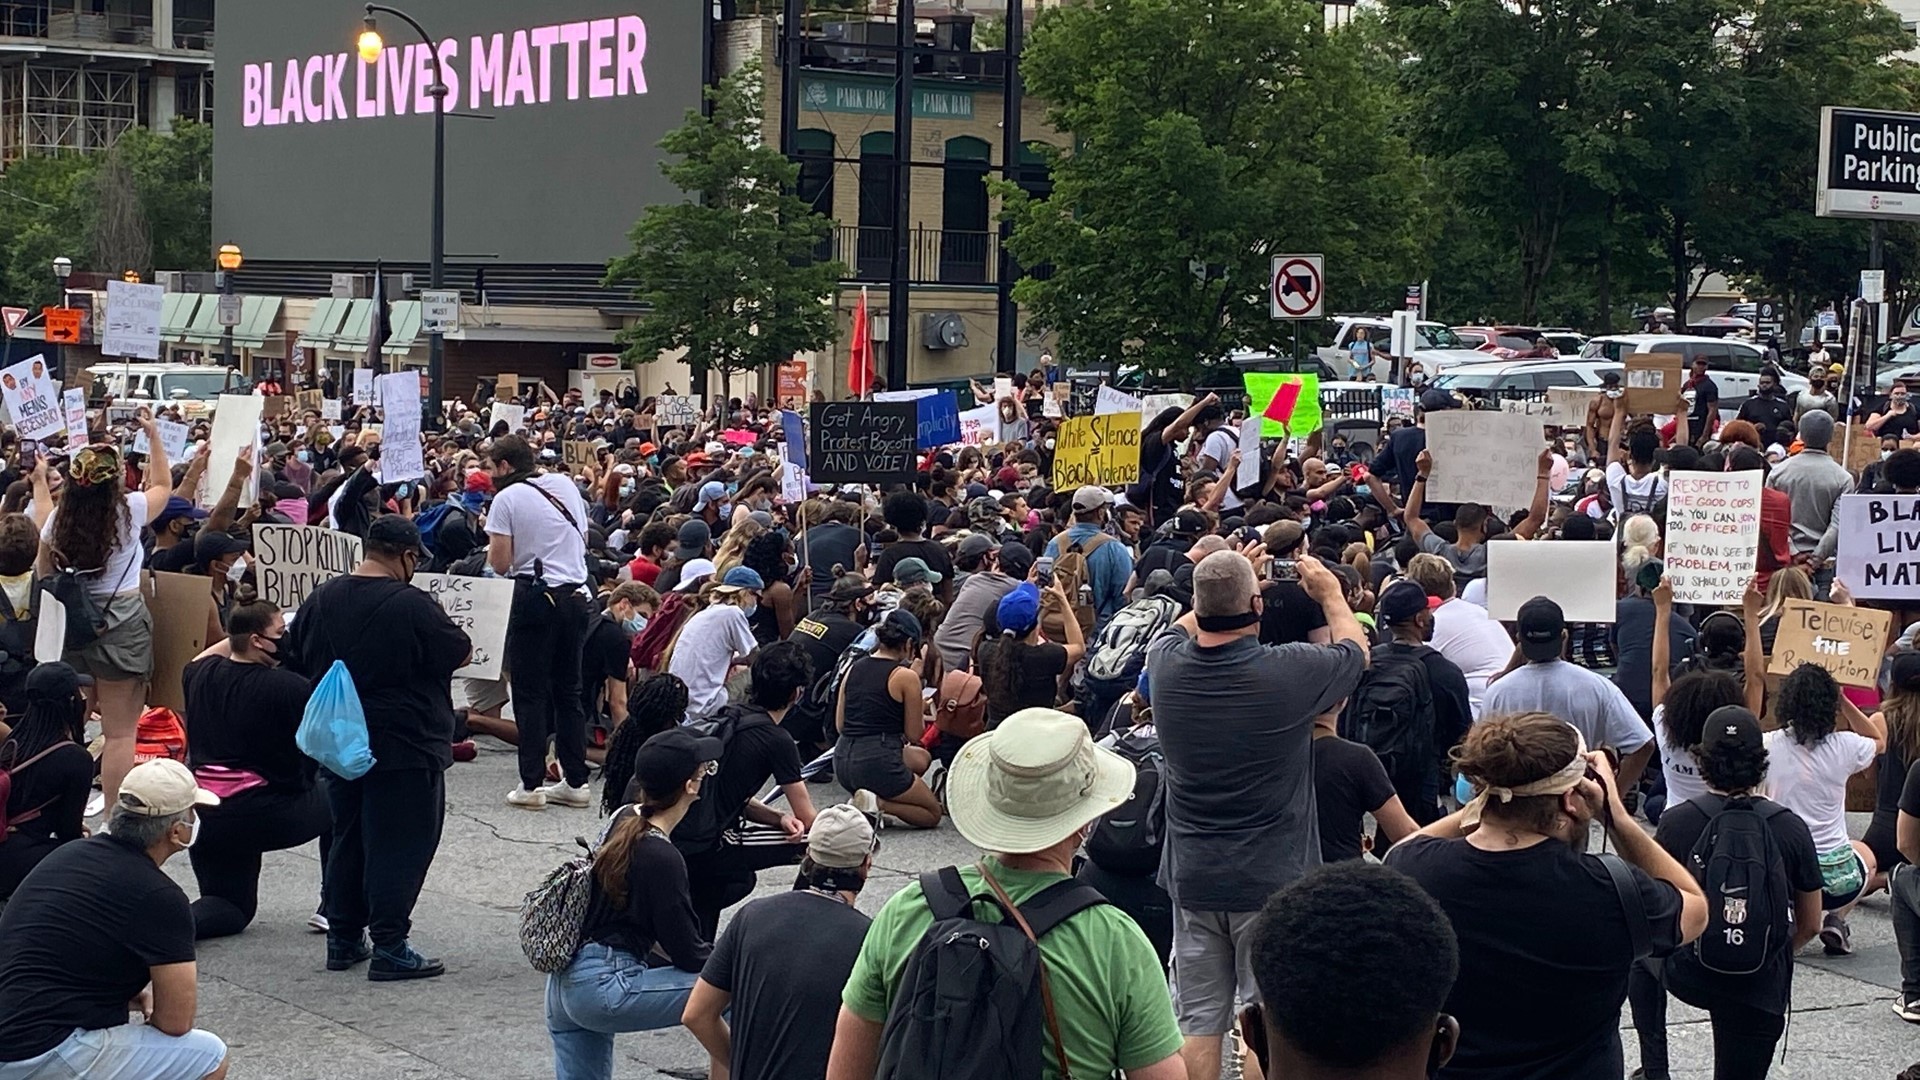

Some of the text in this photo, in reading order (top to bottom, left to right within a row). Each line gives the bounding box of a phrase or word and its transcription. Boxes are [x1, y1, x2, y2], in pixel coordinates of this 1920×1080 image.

[243, 15, 648, 127] BLACK LIVES MATTER
[836, 87, 886, 109] PARK BAR
[922, 92, 971, 115] PARK BAR
[1854, 123, 1920, 153] Public
[423, 296, 457, 305] RIGHT LANE
[432, 308, 448, 316] MUST
[440, 319, 457, 327] RIGHT
[19, 377, 29, 389] BY
[18, 395, 48, 418] MEANS
[656, 395, 691, 406] BLACK
[665, 404, 695, 415] LIVES
[15, 407, 59, 436] NECESSARY
[821, 403, 906, 434] Get Angry
[918, 405, 956, 445] mplicity
[1057, 415, 1138, 450] White Silence
[821, 429, 915, 456] Protest Boycott
[822, 453, 859, 472] AND
[1055, 448, 1138, 489] Black Violence
[1672, 479, 1750, 494] RESPECT TO
[1672, 496, 1755, 509] THE GOOD COPS!
[1688, 508, 1707, 520] YOU
[1713, 512, 1736, 523] CAN
[1738, 513, 1756, 524] JOIN
[1690, 522, 1738, 534] OFFICER
[259, 526, 361, 574] STOP KILLING
[1667, 542, 1678, 554] IF
[1683, 543, 1699, 555] YOU
[1700, 544, 1719, 557] CAN
[1722, 546, 1743, 558] SEE
[1667, 557, 1732, 573] PROBLEM,
[264, 568, 323, 608] BLACK
[430, 578, 472, 593] BLACK
[1668, 574, 1753, 587] YOU SHOULD BE
[1673, 589, 1744, 601] OING MORE
[1790, 607, 1874, 640] Televise
[1672, 764, 1693, 776] AM
[1723, 928, 1745, 946] 16
